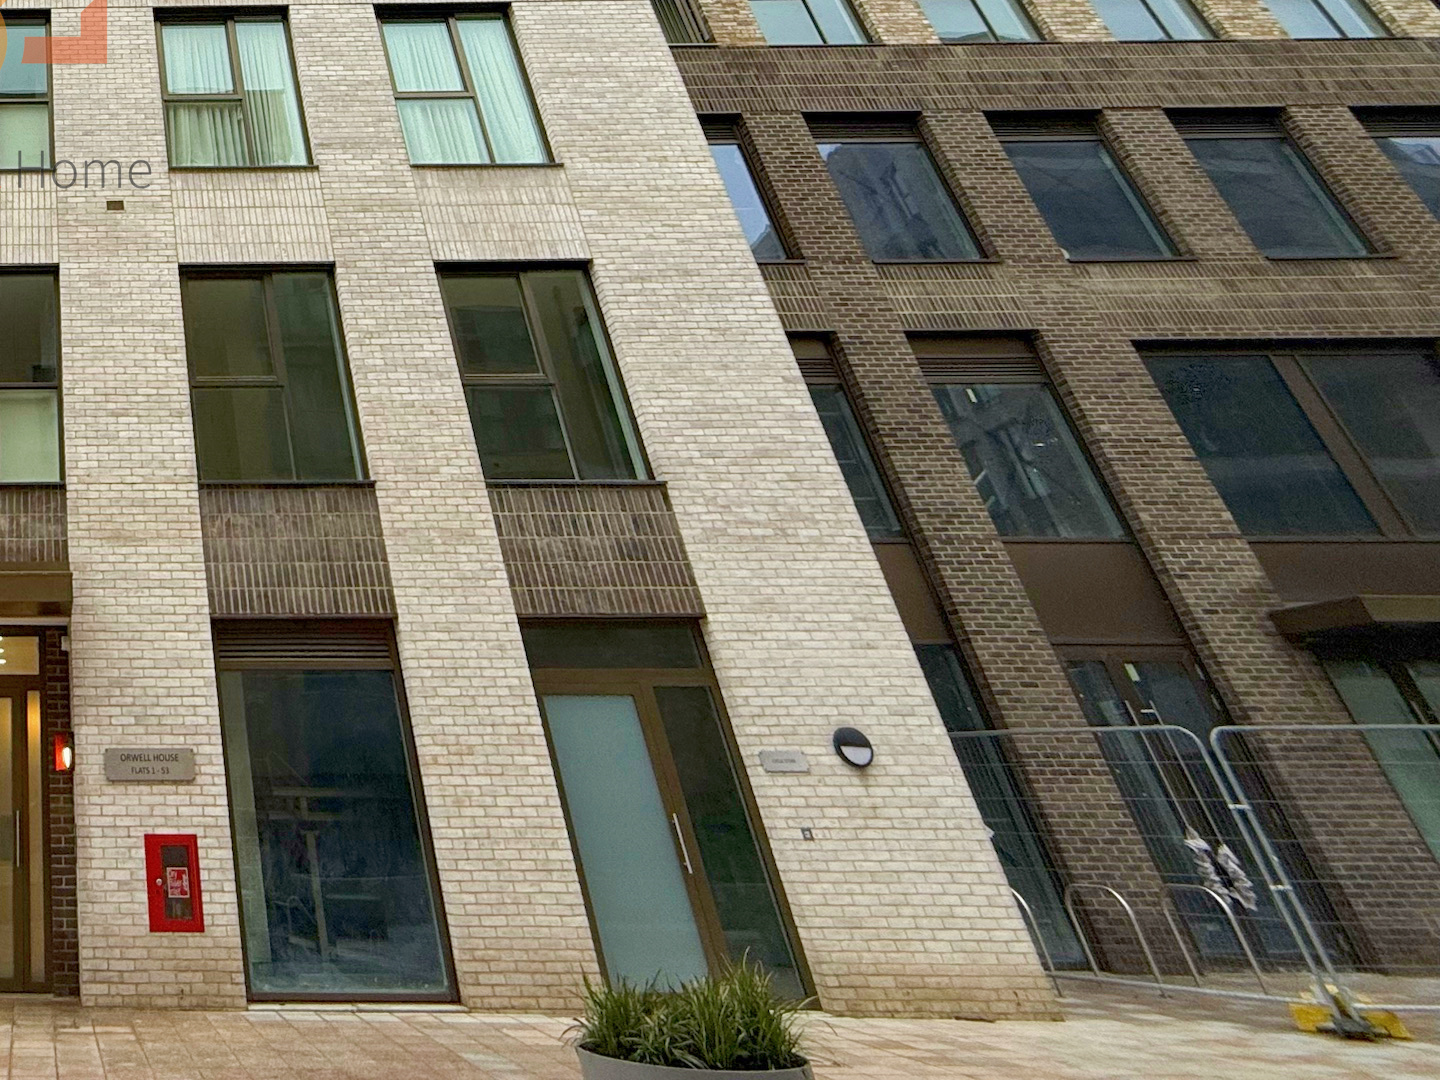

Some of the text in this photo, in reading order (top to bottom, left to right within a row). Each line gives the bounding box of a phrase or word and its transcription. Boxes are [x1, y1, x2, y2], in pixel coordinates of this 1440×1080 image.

[120, 753, 179, 762] ORWELL HOUSE
[131, 767, 150, 775] FLATS
